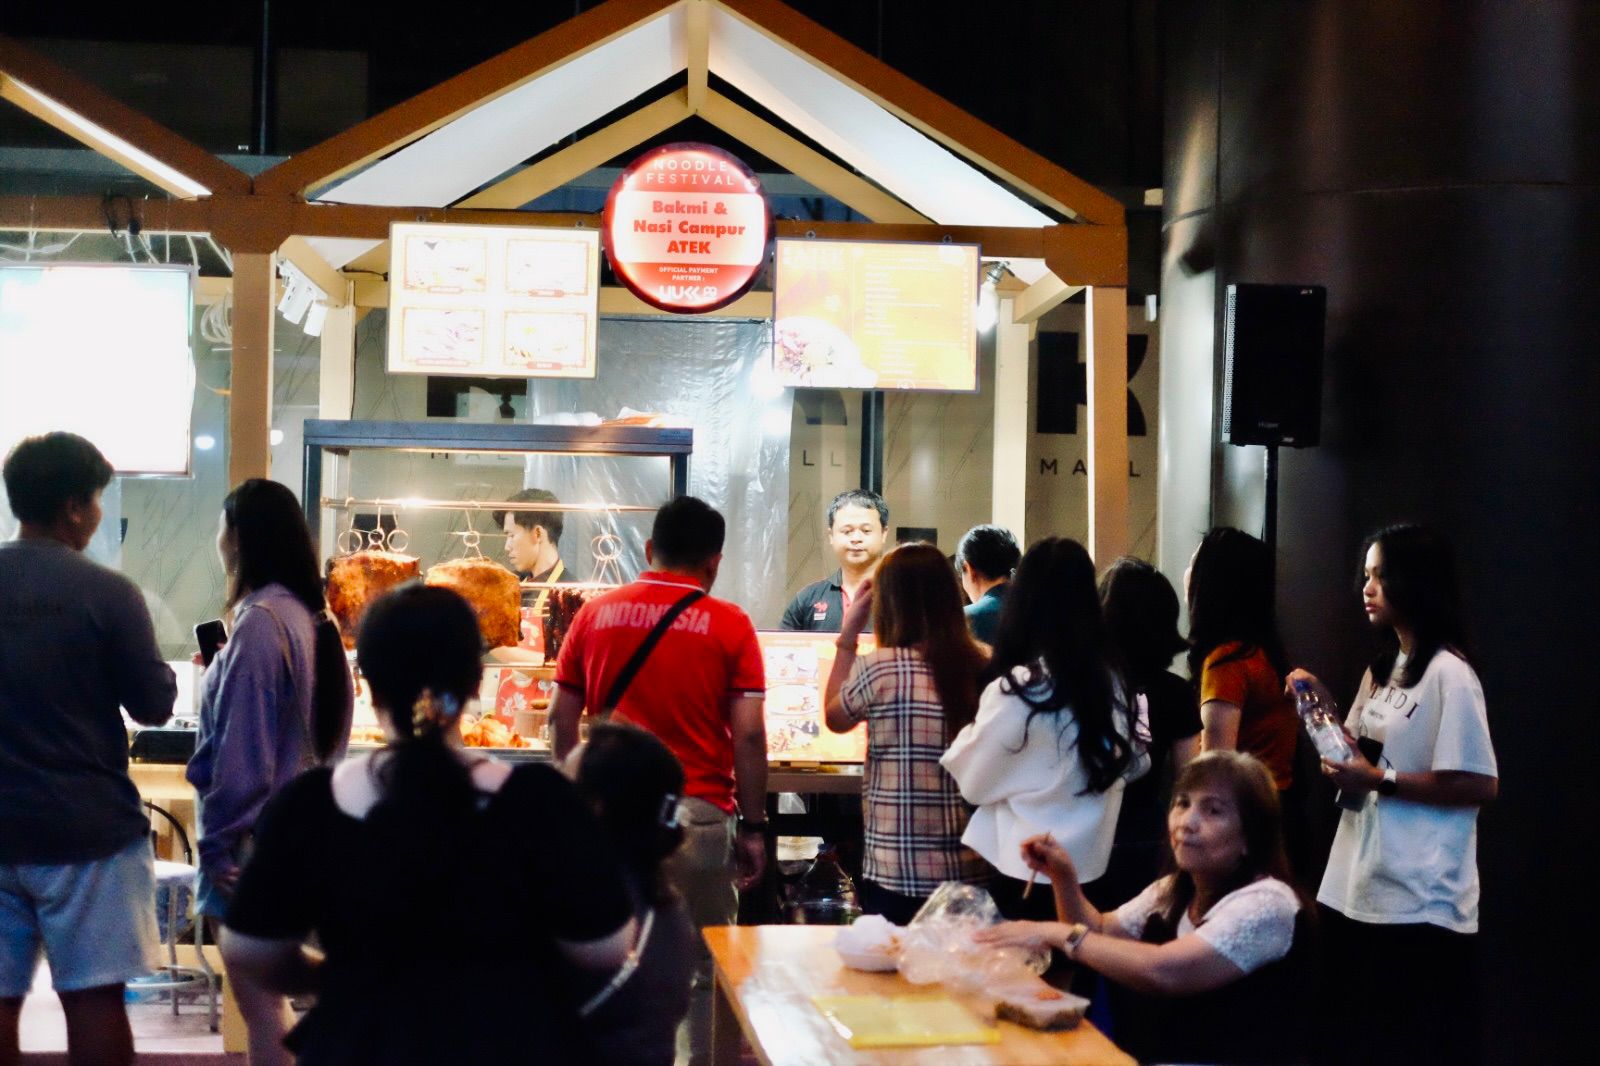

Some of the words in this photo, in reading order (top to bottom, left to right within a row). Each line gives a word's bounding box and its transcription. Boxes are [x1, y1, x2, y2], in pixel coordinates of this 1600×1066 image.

[653, 159, 728, 172] NOODLE
[646, 173, 735, 186] FESTIVAL
[652, 200, 708, 215] Bakmi
[713, 202, 728, 215] &
[633, 220, 672, 233] Nasi
[678, 220, 746, 239] Campur
[667, 241, 711, 254] ATEK
[689, 267, 719, 275] PAYMENT
[1039, 459, 1141, 477] MAL
